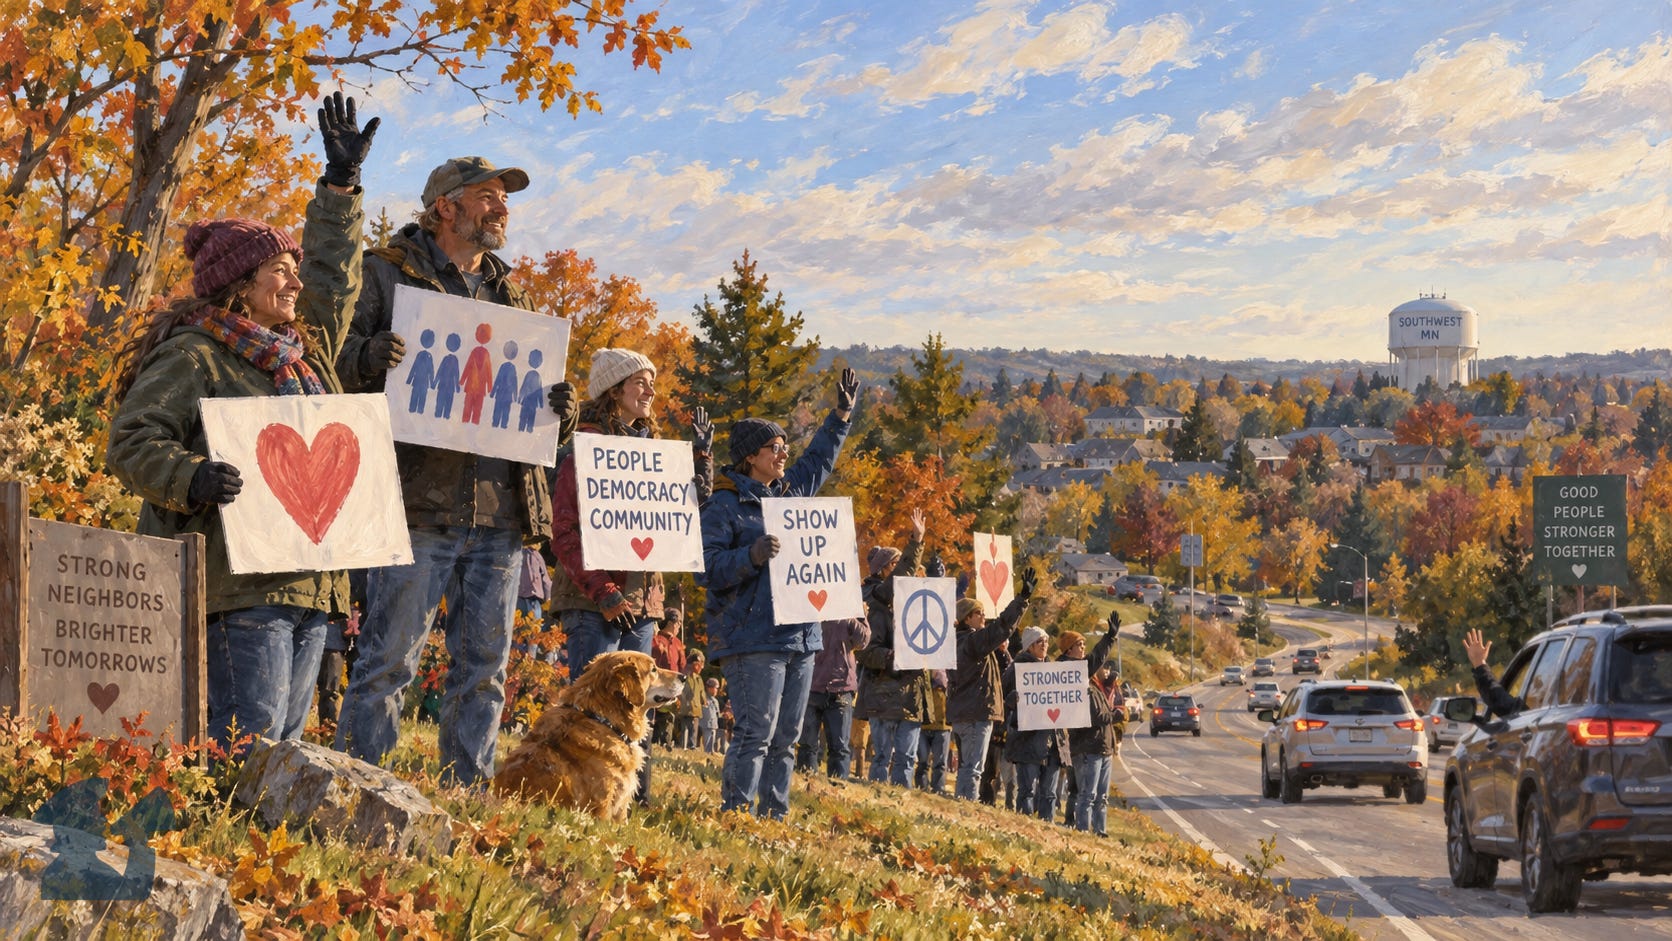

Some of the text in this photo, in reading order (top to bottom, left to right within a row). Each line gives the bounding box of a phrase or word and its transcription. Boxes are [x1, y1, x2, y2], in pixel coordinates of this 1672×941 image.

[1399, 316, 1462, 328] SOUTHWEST
[1421, 329, 1440, 340] MN
[593, 447, 663, 473] PEOPLE
[586, 477, 689, 506] DEMOCRACY
[1560, 486, 1599, 498] GOOD
[590, 508, 693, 535] COMMUNITY
[783, 508, 838, 530] SHOW
[1554, 505, 1605, 518] PEOPLE
[1544, 526, 1615, 538] STRONGER
[800, 535, 827, 557] UP
[1545, 546, 1615, 558] TOGETHER
[57, 554, 147, 582] STRONG
[786, 562, 847, 585] AGAIN
[47, 583, 164, 612] NEIGHBORS
[55, 619, 153, 645] BRIGHTER
[41, 647, 167, 674] TOMORROWS
[1022, 670, 1082, 686] STRONGER
[1024, 690, 1083, 704] TOGETHER
